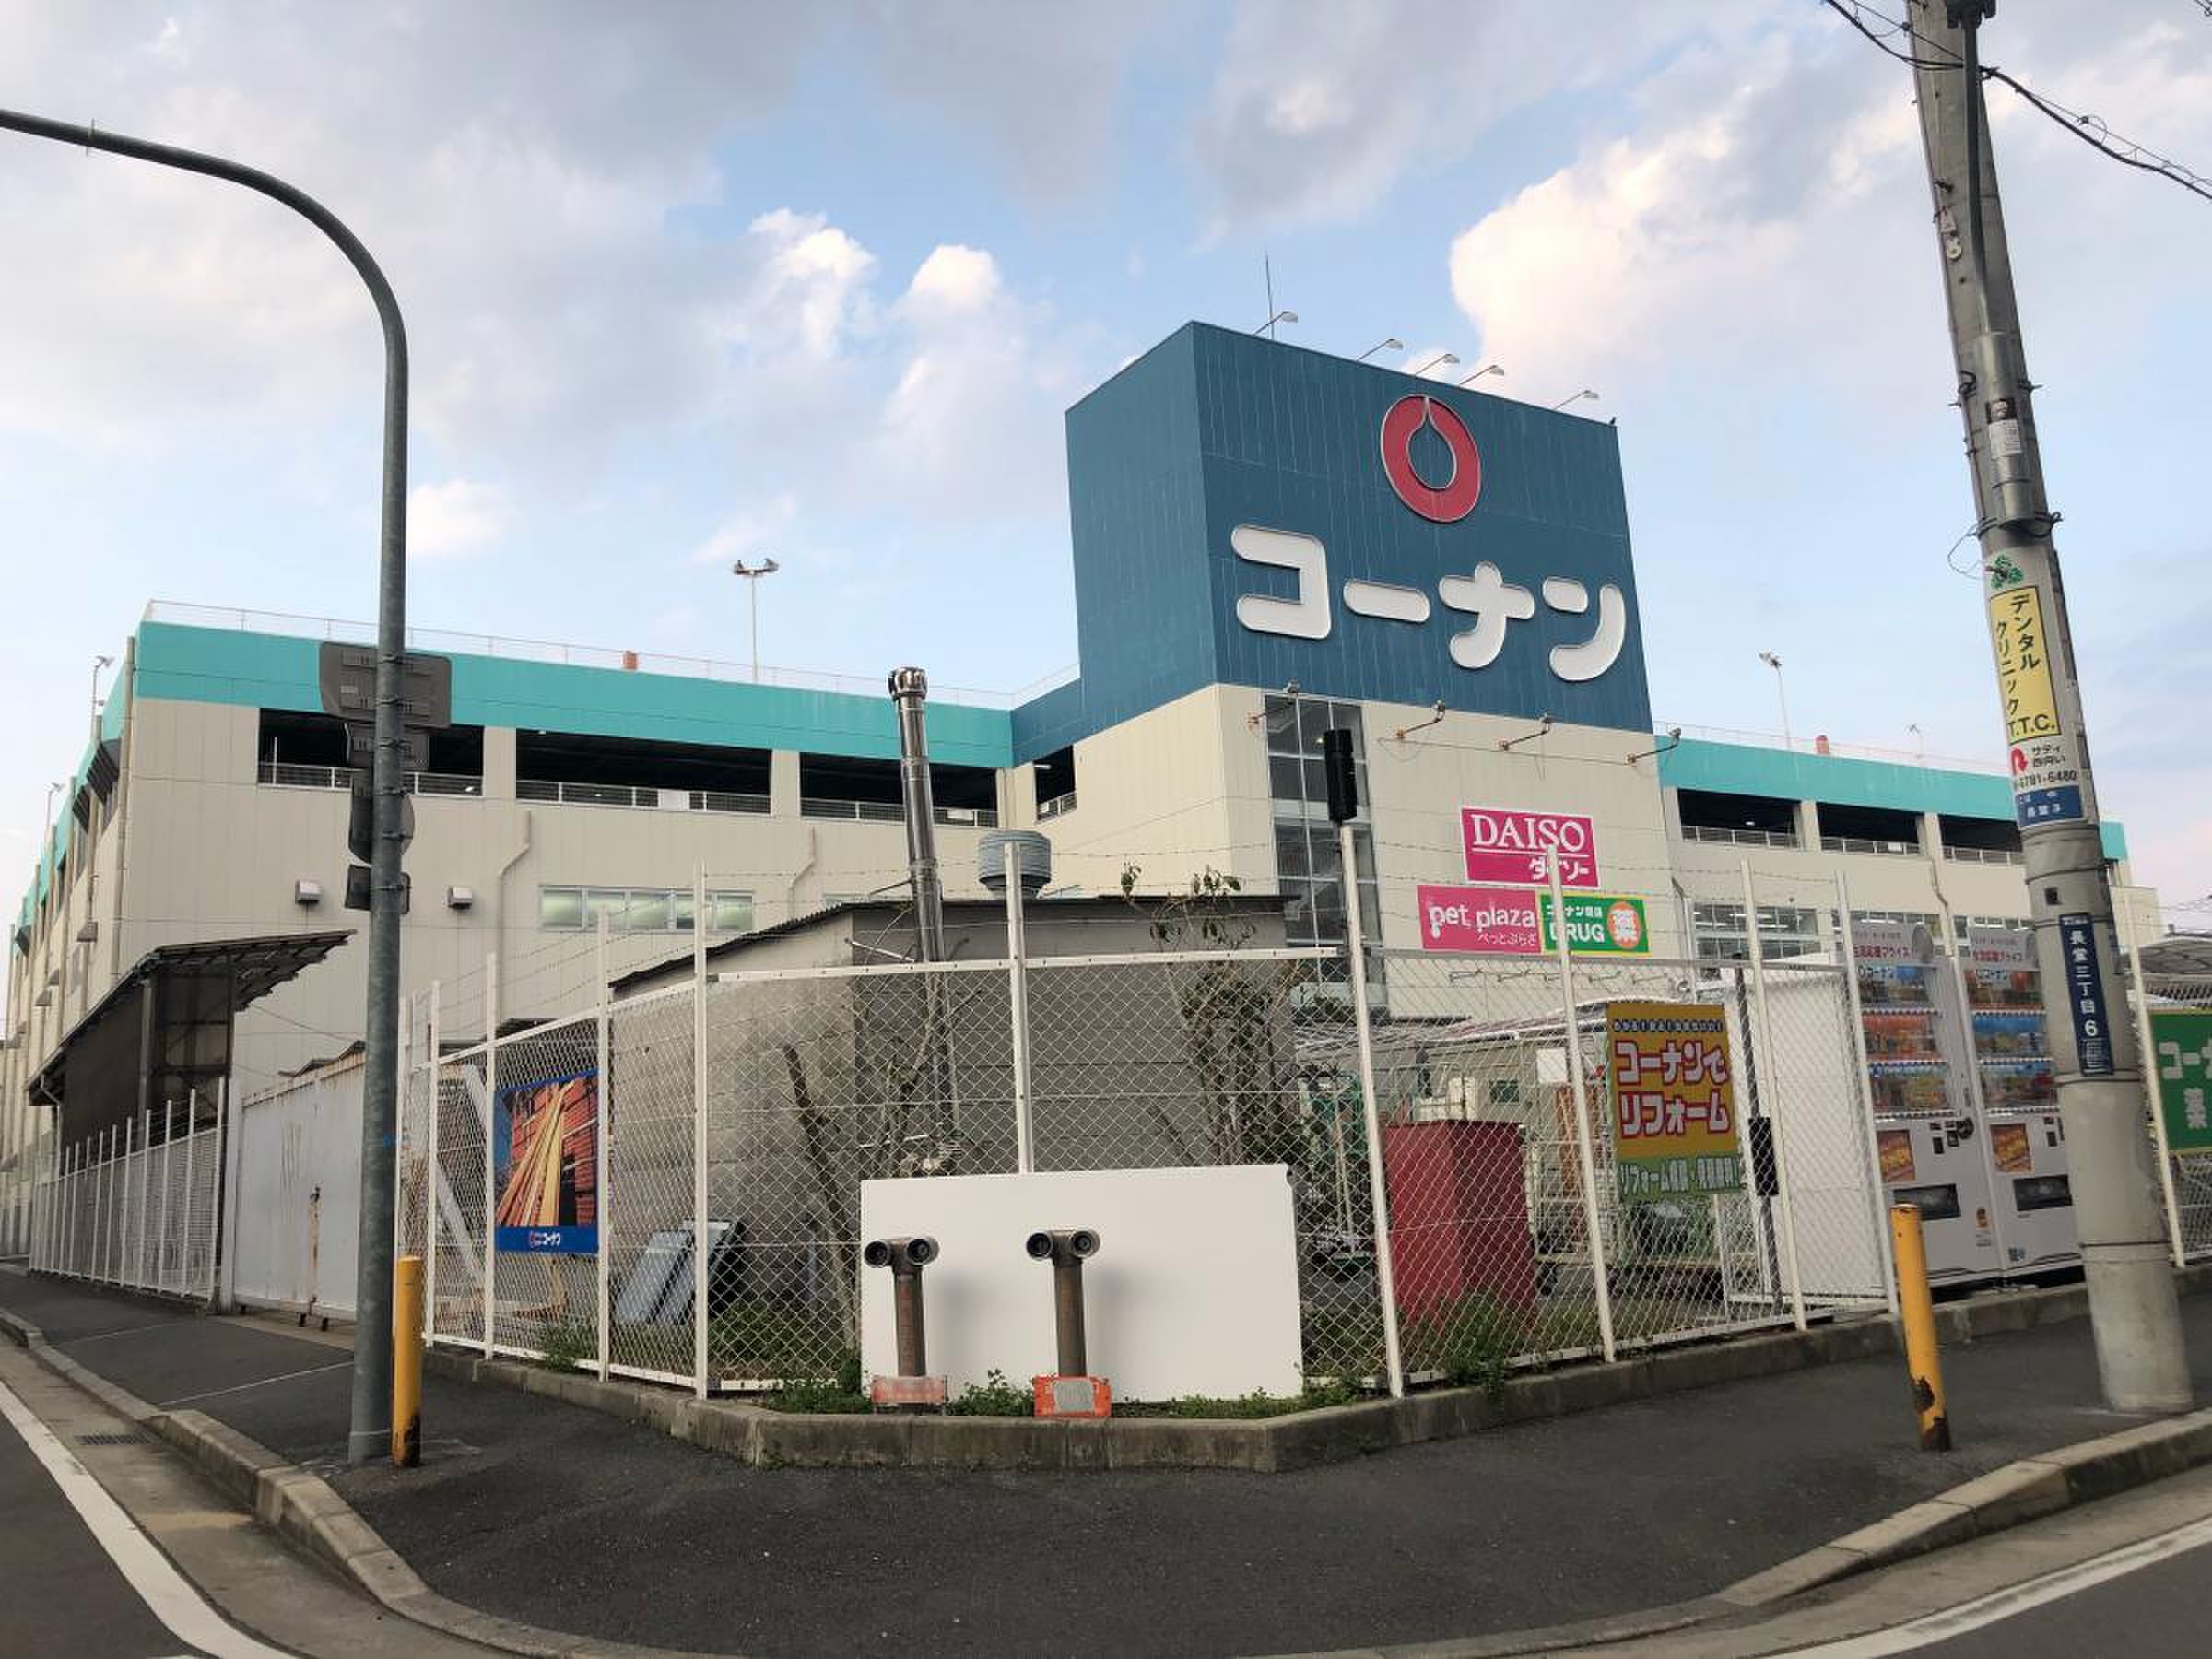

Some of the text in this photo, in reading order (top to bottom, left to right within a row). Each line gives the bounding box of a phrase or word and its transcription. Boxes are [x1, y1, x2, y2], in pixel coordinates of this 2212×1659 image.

[1231, 524, 1626, 681] コーナン
[2010, 593, 2041, 671] デンタル
[1996, 620, 2019, 715] クリニック
[1470, 814, 1585, 853] DAISO
[1528, 855, 1590, 881] ダソー
[1427, 901, 1535, 939] pet plaza
[1619, 1089, 1730, 1137] リフォーム
